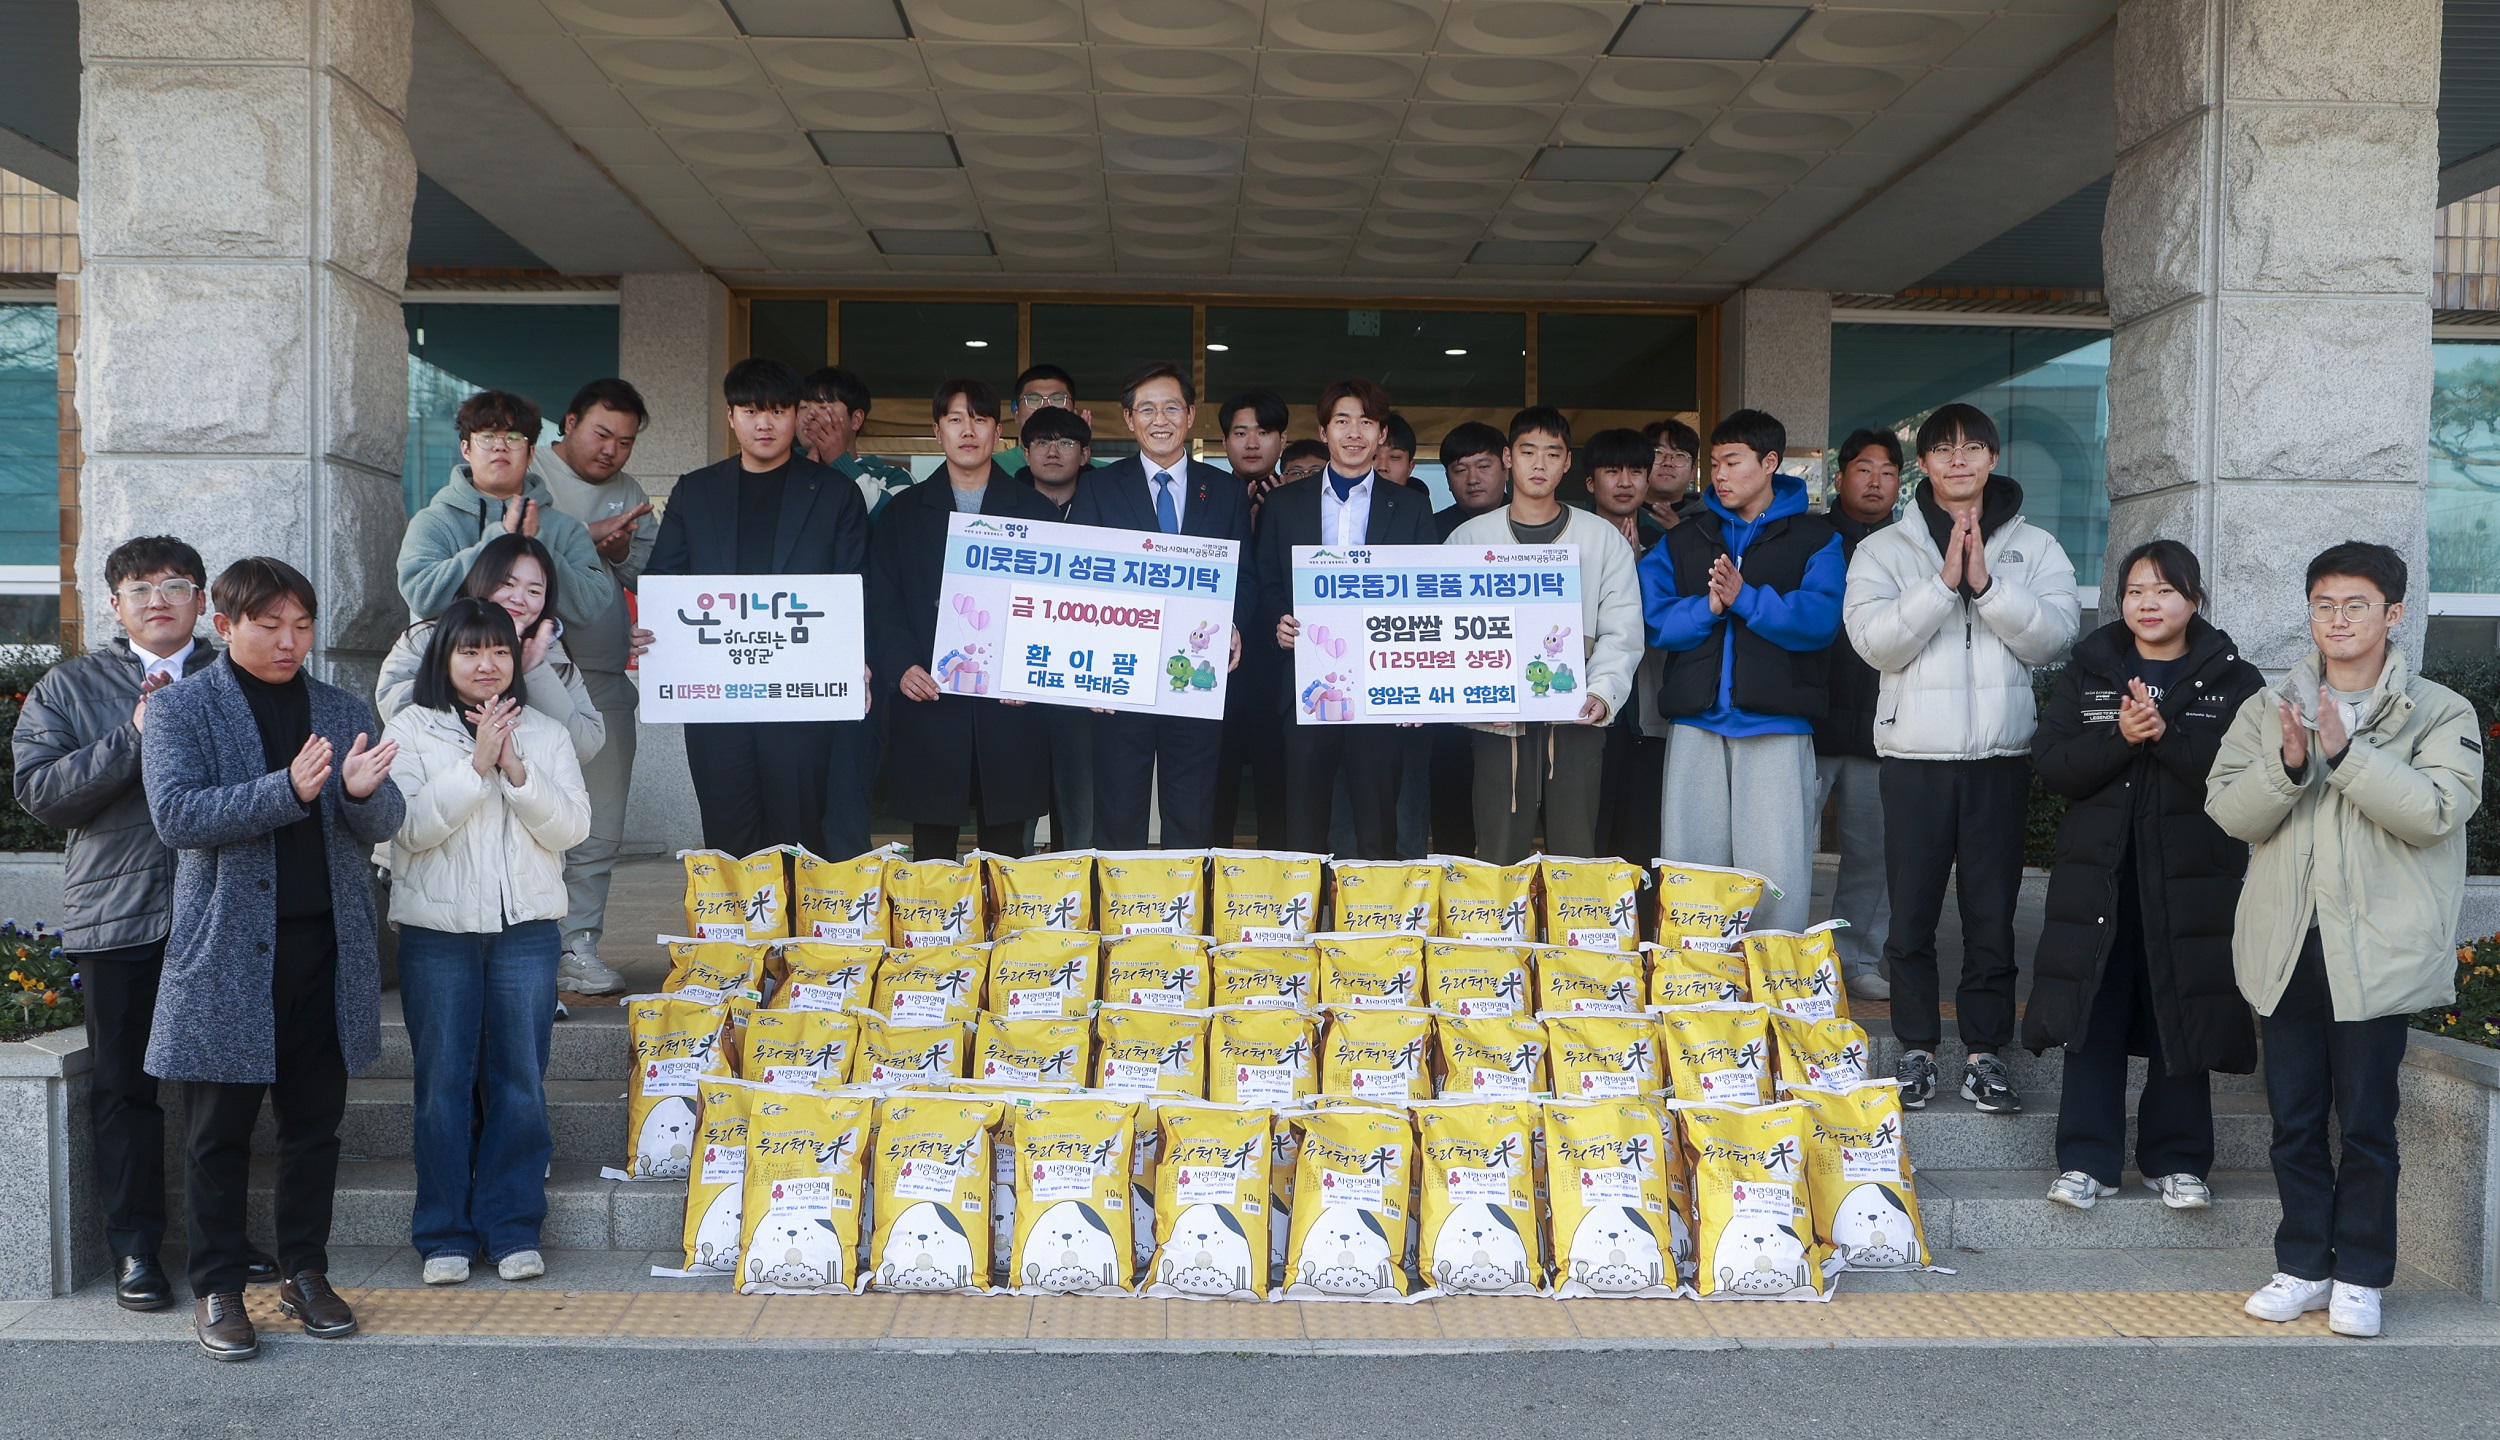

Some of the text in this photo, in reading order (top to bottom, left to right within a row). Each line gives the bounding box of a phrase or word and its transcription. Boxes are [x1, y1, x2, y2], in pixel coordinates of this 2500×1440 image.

[1005, 523, 1028, 538] 영암
[1348, 550, 1372, 564] 영암
[964, 543, 1221, 593] 이웃돕기 성금 지정기탁
[1313, 572, 1564, 599] 이웃돕기 물품 지정기탁
[678, 592, 825, 645] 온기나눔
[1011, 595, 1161, 631] 금 1,000,000원
[1365, 614, 1513, 643] 영암쌀 50포
[723, 630, 787, 649] 하나되는
[728, 648, 774, 664] 영암군
[1025, 643, 1138, 676] 환 이 팜
[1368, 648, 1512, 671] (125만원 상당)
[1027, 670, 1130, 696] 대표 박태승
[659, 681, 848, 700] 더 따뜻한 영암군을 만듭니다!
[1367, 684, 1517, 705] 영암군 4H 연합회
[1854, 1147, 1896, 1161] 사랑의열매
[915, 1163, 957, 1179] 사랑의열매
[1048, 1164, 1092, 1177] 사랑의열매
[1193, 1170, 1236, 1184] 사랑의열매
[1462, 1171, 1506, 1182] 사랑의열매
[1595, 1171, 1637, 1184] 사랑의열매
[786, 1181, 830, 1196] 사랑의열매
[1337, 1177, 1380, 1189] 사랑의열매
[834, 1187, 852, 1199] 10kg
[963, 1191, 981, 1202] 10kg
[1105, 1189, 1123, 1199] 10kg
[1243, 1193, 1261, 1204] 10kg
[1512, 1190, 1528, 1200] 10kg
[1645, 1193, 1662, 1203] 10kg
[1747, 1187, 1790, 1200] 사랑의열매
[1384, 1198, 1401, 1210] 10kg
